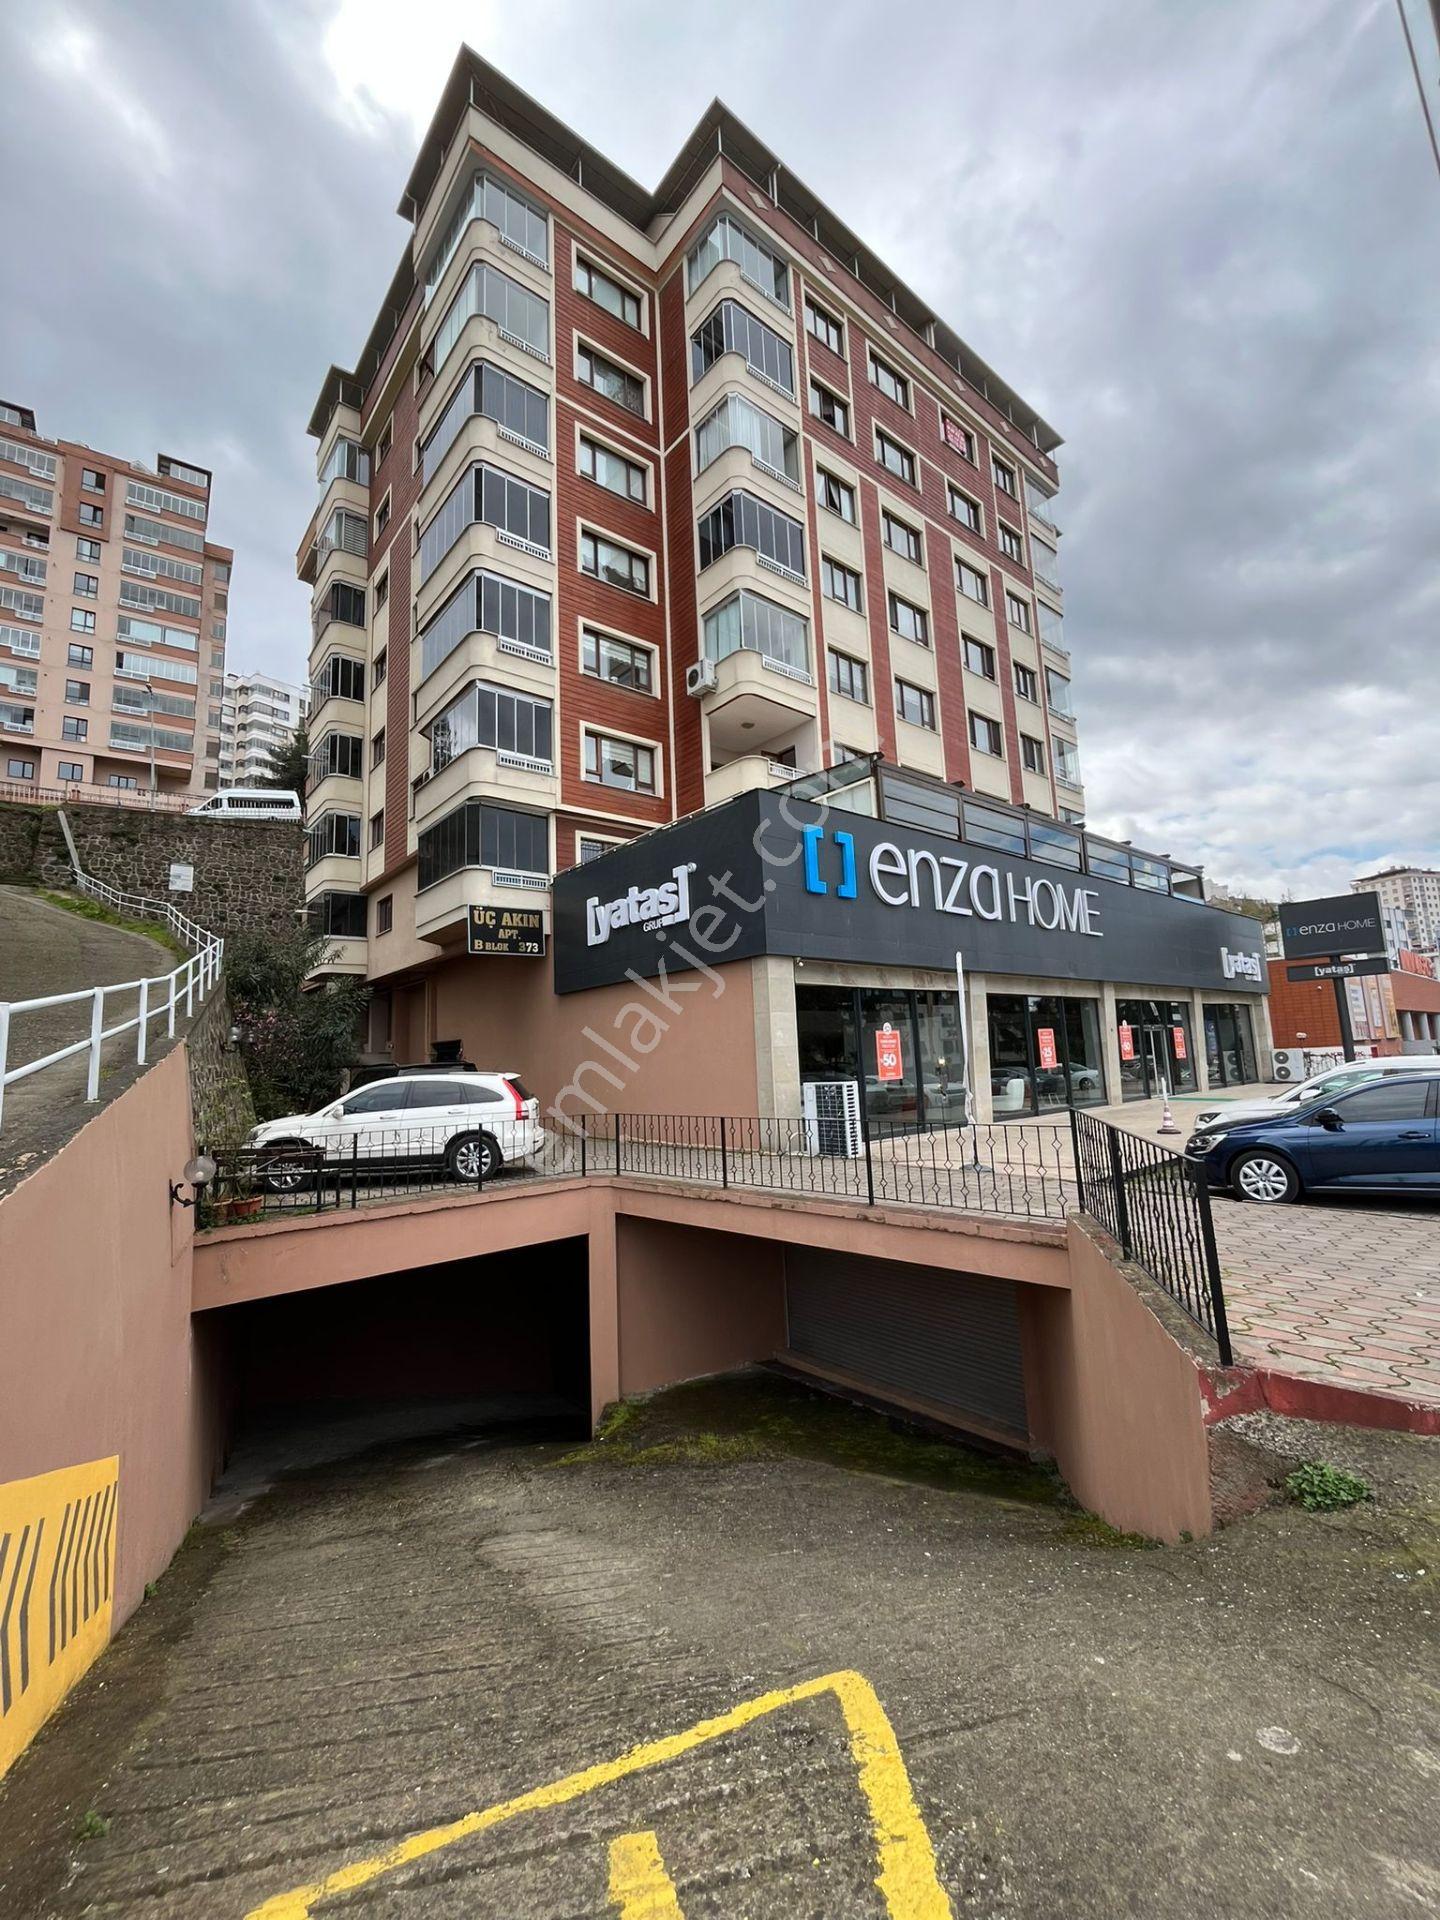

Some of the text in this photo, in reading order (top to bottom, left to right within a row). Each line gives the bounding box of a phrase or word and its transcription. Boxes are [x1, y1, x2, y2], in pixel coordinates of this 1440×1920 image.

[869, 842, 1103, 936] enza HOME
[473, 906, 540, 928] ÜÇ AKIN
[498, 929, 521, 939] APT.
[1300, 918, 1376, 935] enza HOME
[474, 939, 539, 952] B BLOK 373
